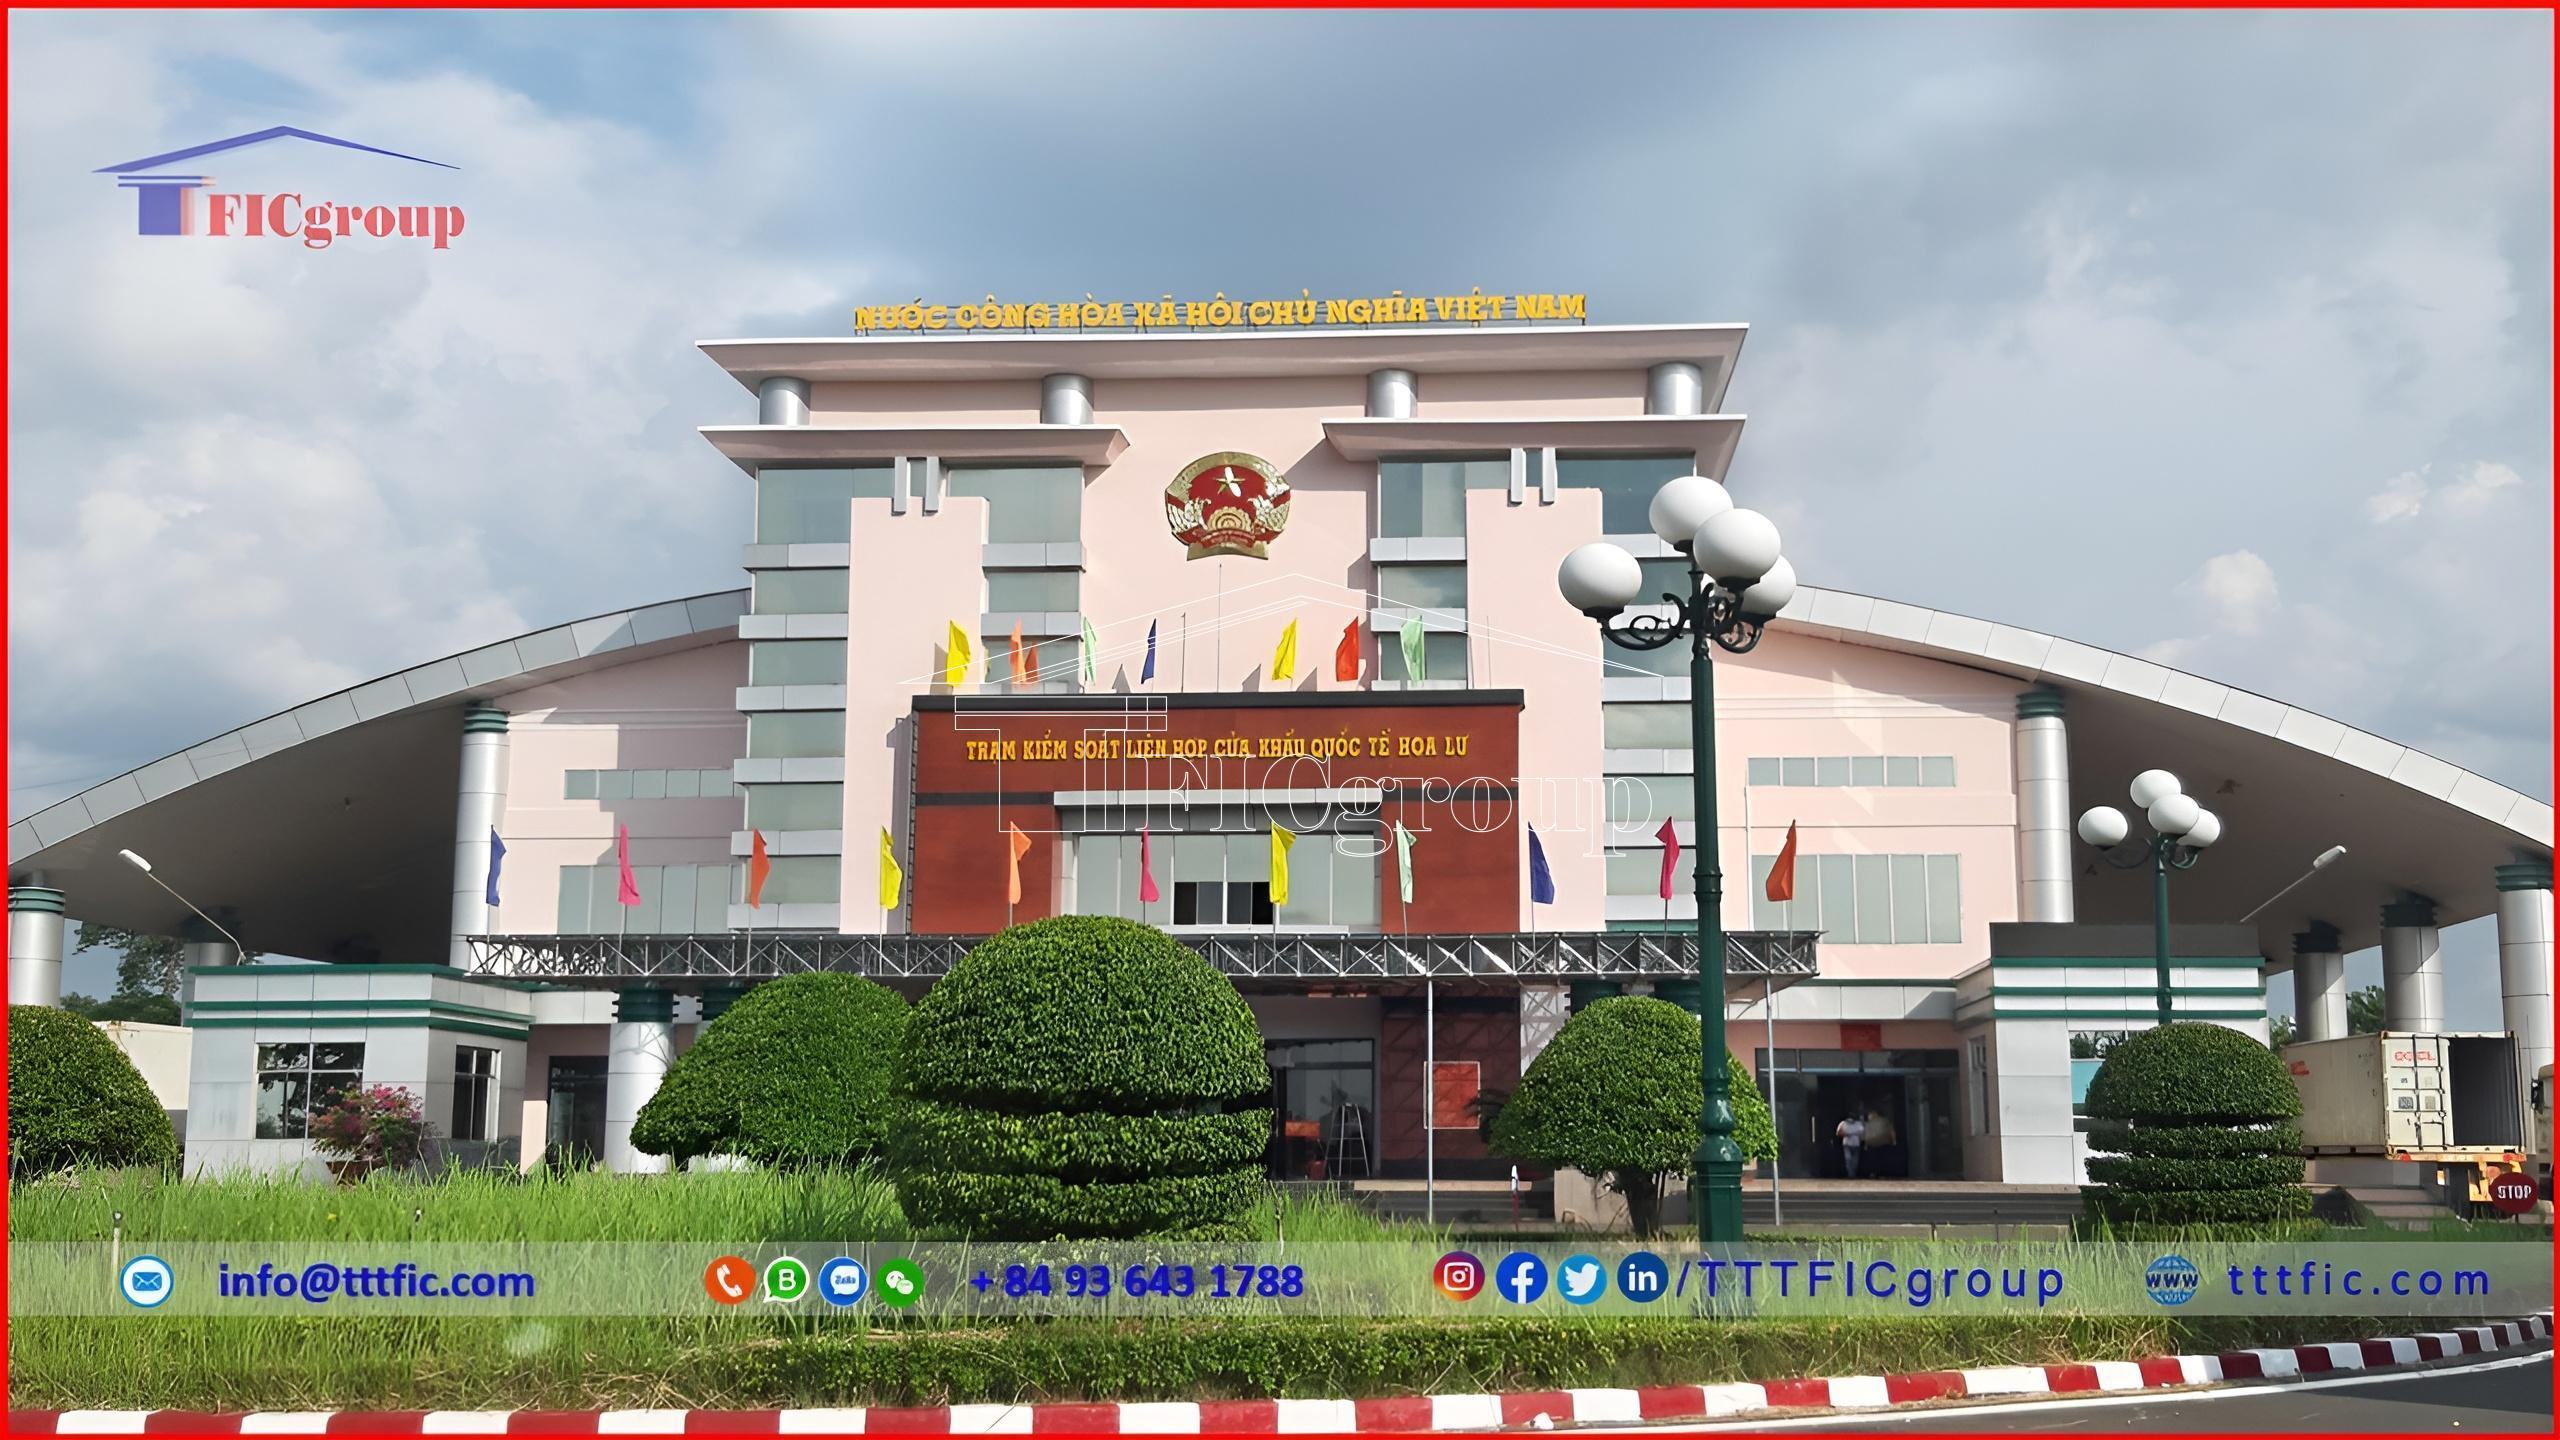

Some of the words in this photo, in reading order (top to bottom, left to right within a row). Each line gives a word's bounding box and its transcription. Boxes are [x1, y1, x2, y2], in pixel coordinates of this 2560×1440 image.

[855, 298, 948, 330] NƯỚC
[955, 293, 1050, 329] CÔNG
[1058, 292, 1125, 327] HÒA
[1134, 292, 1178, 326] XÃ
[1248, 288, 1317, 326] CHỦ
[1326, 289, 1428, 324] NGHĨA
[1434, 286, 1505, 327] VIỆT
[1515, 294, 1586, 319] NAM
[966, 740, 1016, 765] TRẠM
[1022, 729, 1067, 760] KIỂM
[1073, 732, 1120, 760] SOÁT
[1126, 733, 1167, 759] LIÊN
[1398, 736, 1437, 756] HOA
[1445, 734, 1469, 756] LƯ
[2497, 1184, 2532, 1199] STOP
